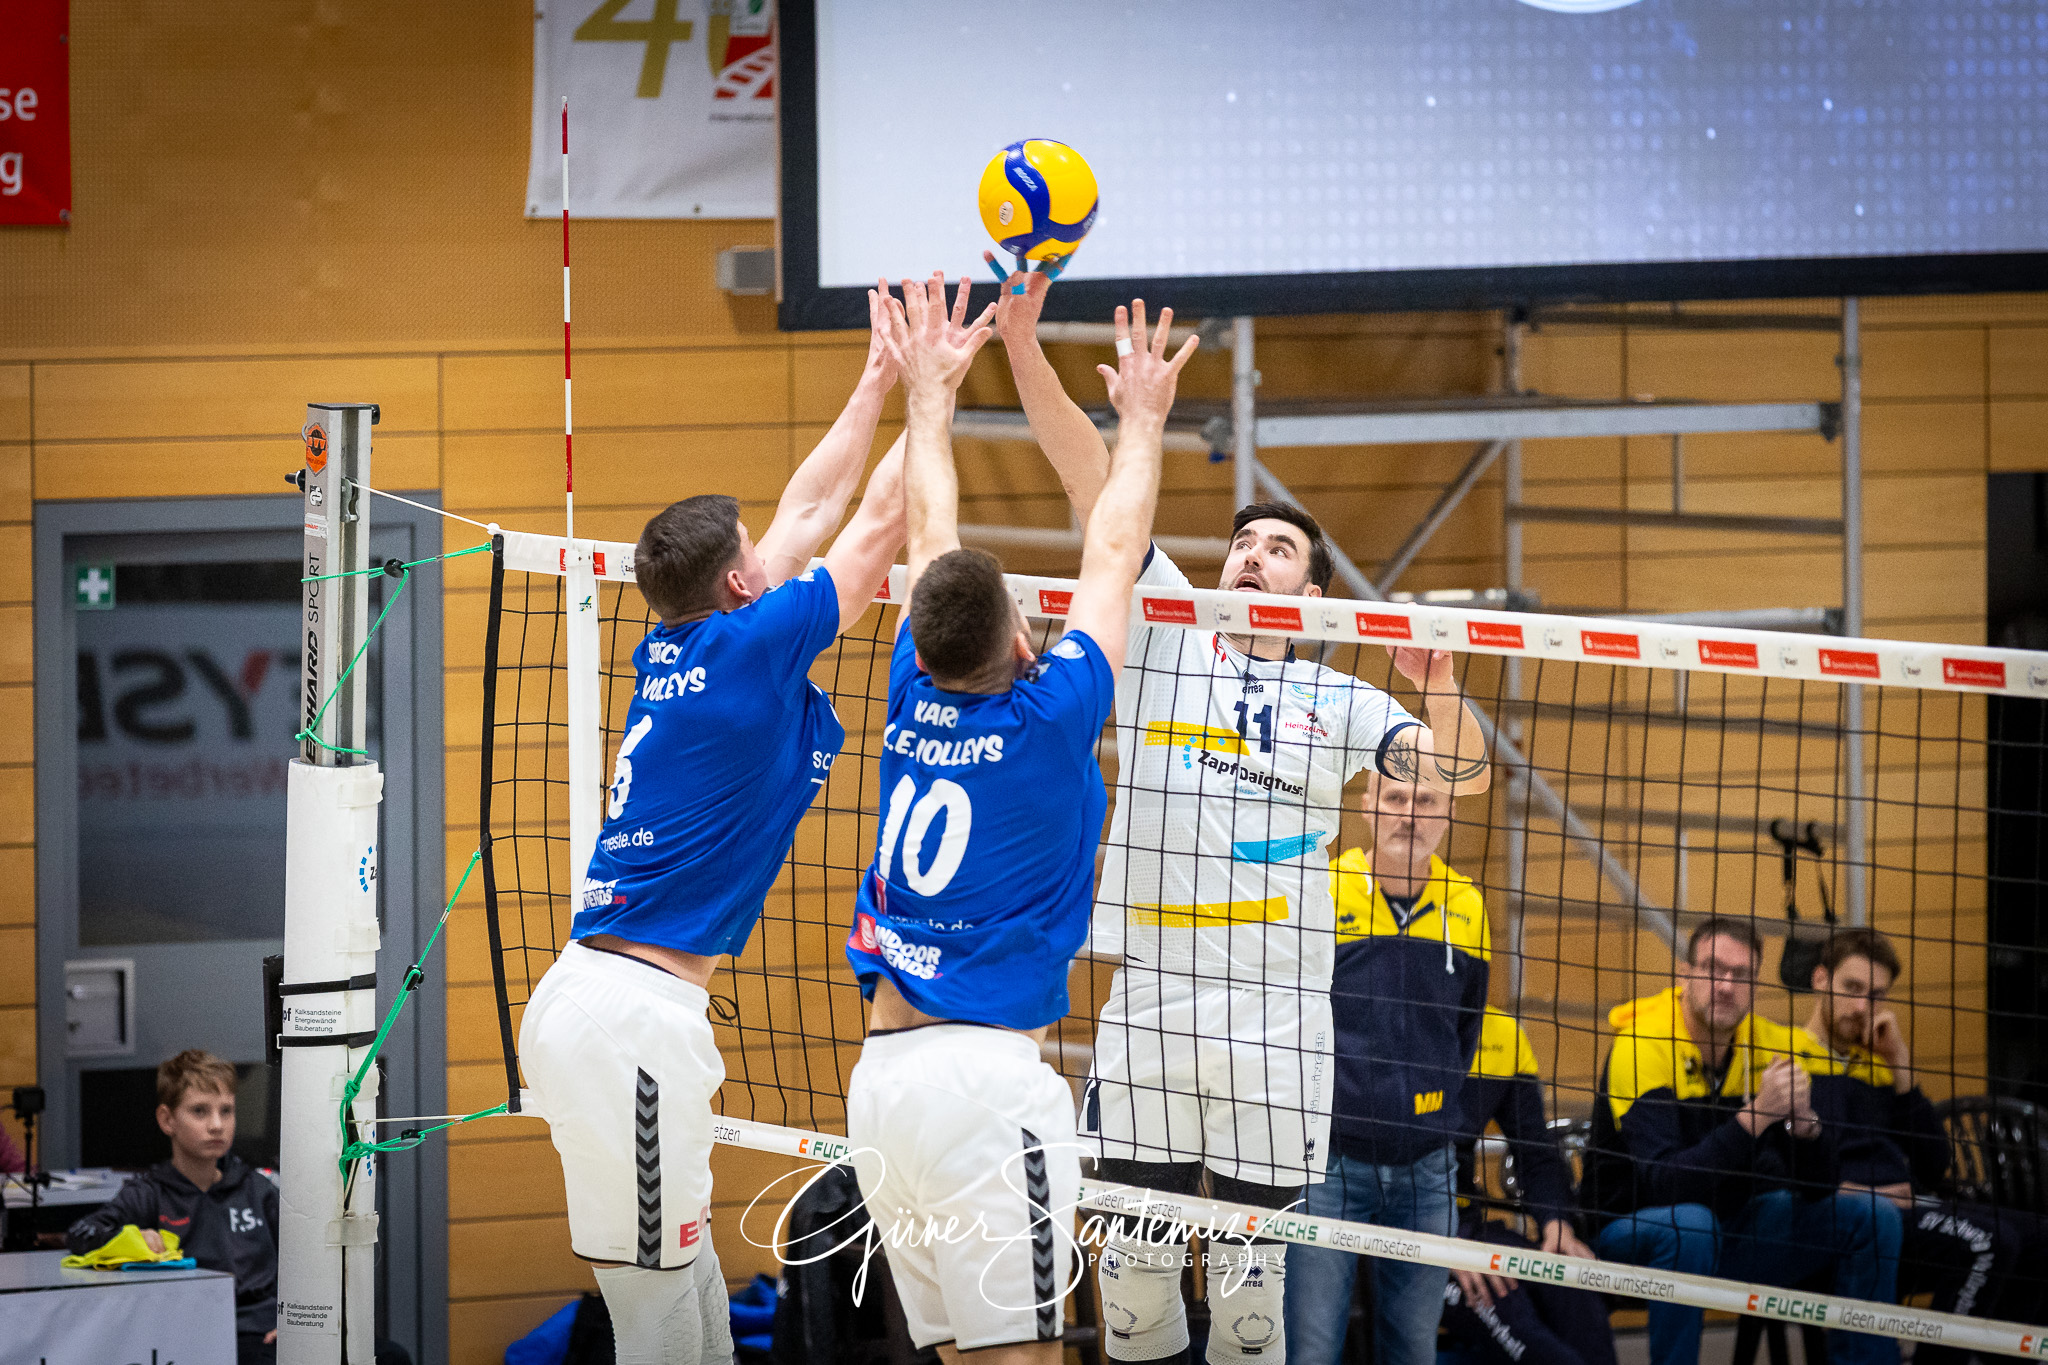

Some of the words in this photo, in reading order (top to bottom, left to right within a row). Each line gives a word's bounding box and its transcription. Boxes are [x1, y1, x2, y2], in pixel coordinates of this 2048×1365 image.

[307, 551, 321, 624] SPORT
[1233, 700, 1273, 754] 11
[879, 773, 972, 897] 10
[874, 924, 942, 966] INDOOR
[294, 1008, 342, 1016] Kalksandsteine
[294, 1016, 337, 1025] Energiewände
[294, 1024, 333, 1033] Bauberatung
[1094, 1187, 1126, 1209] Ideen
[1262, 1217, 1319, 1242] FUCHS
[1328, 1226, 1361, 1249] Ideen
[1363, 1234, 1421, 1259] umsetzen
[1506, 1255, 1566, 1282] FUCHS
[1577, 1265, 1611, 1290] Ideen
[1614, 1274, 1675, 1299] umsetzen
[286, 1302, 333, 1311] Kalksandsteine
[286, 1310, 328, 1319] Energiewände
[1765, 1296, 1828, 1322] FUCHS
[1839, 1305, 1875, 1330] Ideen
[1878, 1316, 1944, 1341] umsetzen
[286, 1318, 324, 1328] Bauberatung
